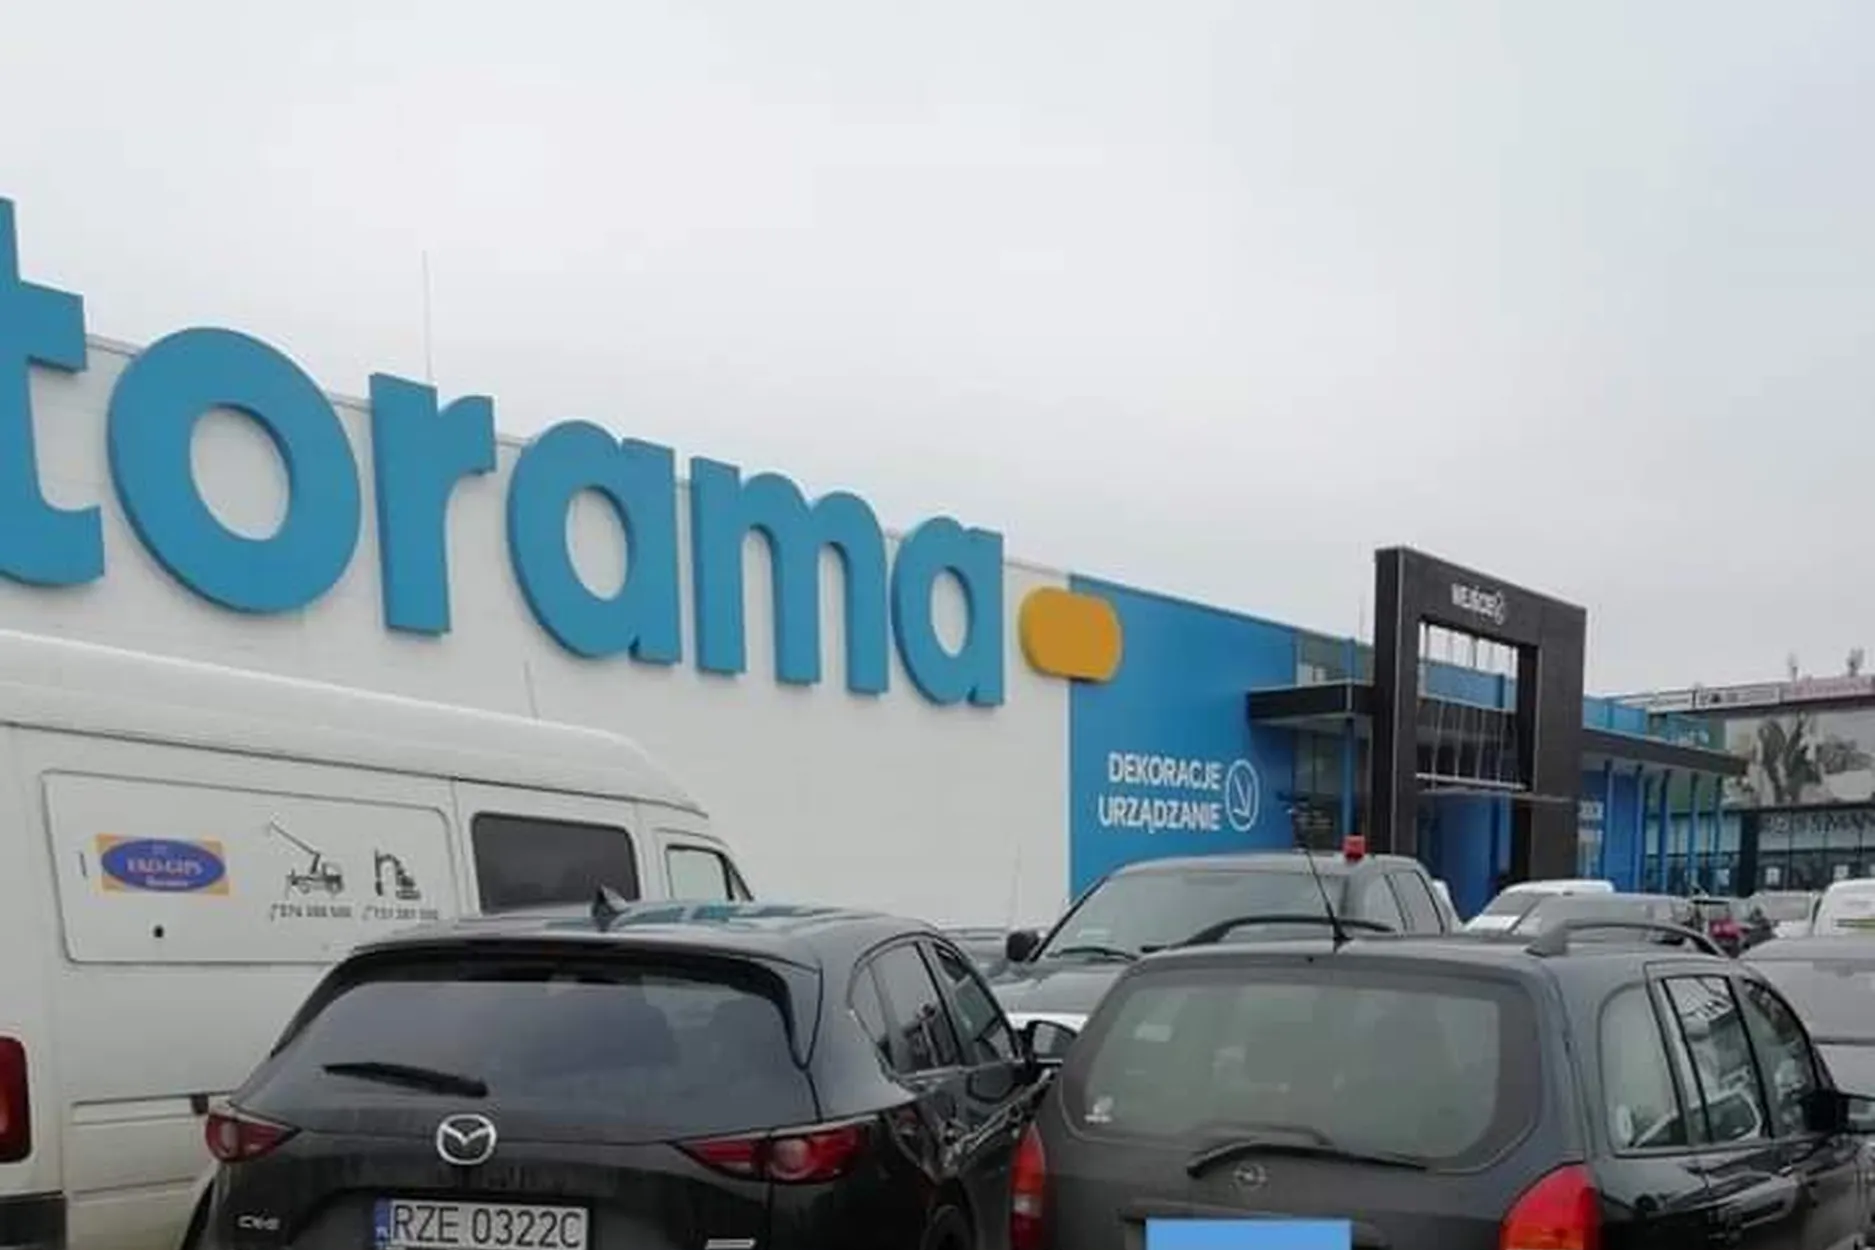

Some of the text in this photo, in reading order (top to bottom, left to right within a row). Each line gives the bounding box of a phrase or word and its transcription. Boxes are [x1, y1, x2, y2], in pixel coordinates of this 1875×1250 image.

[1108, 752, 1222, 790] DEKORACJE
[1098, 793, 1221, 833] URZĄDZANIE
[392, 1204, 581, 1249] RZE 0322C
